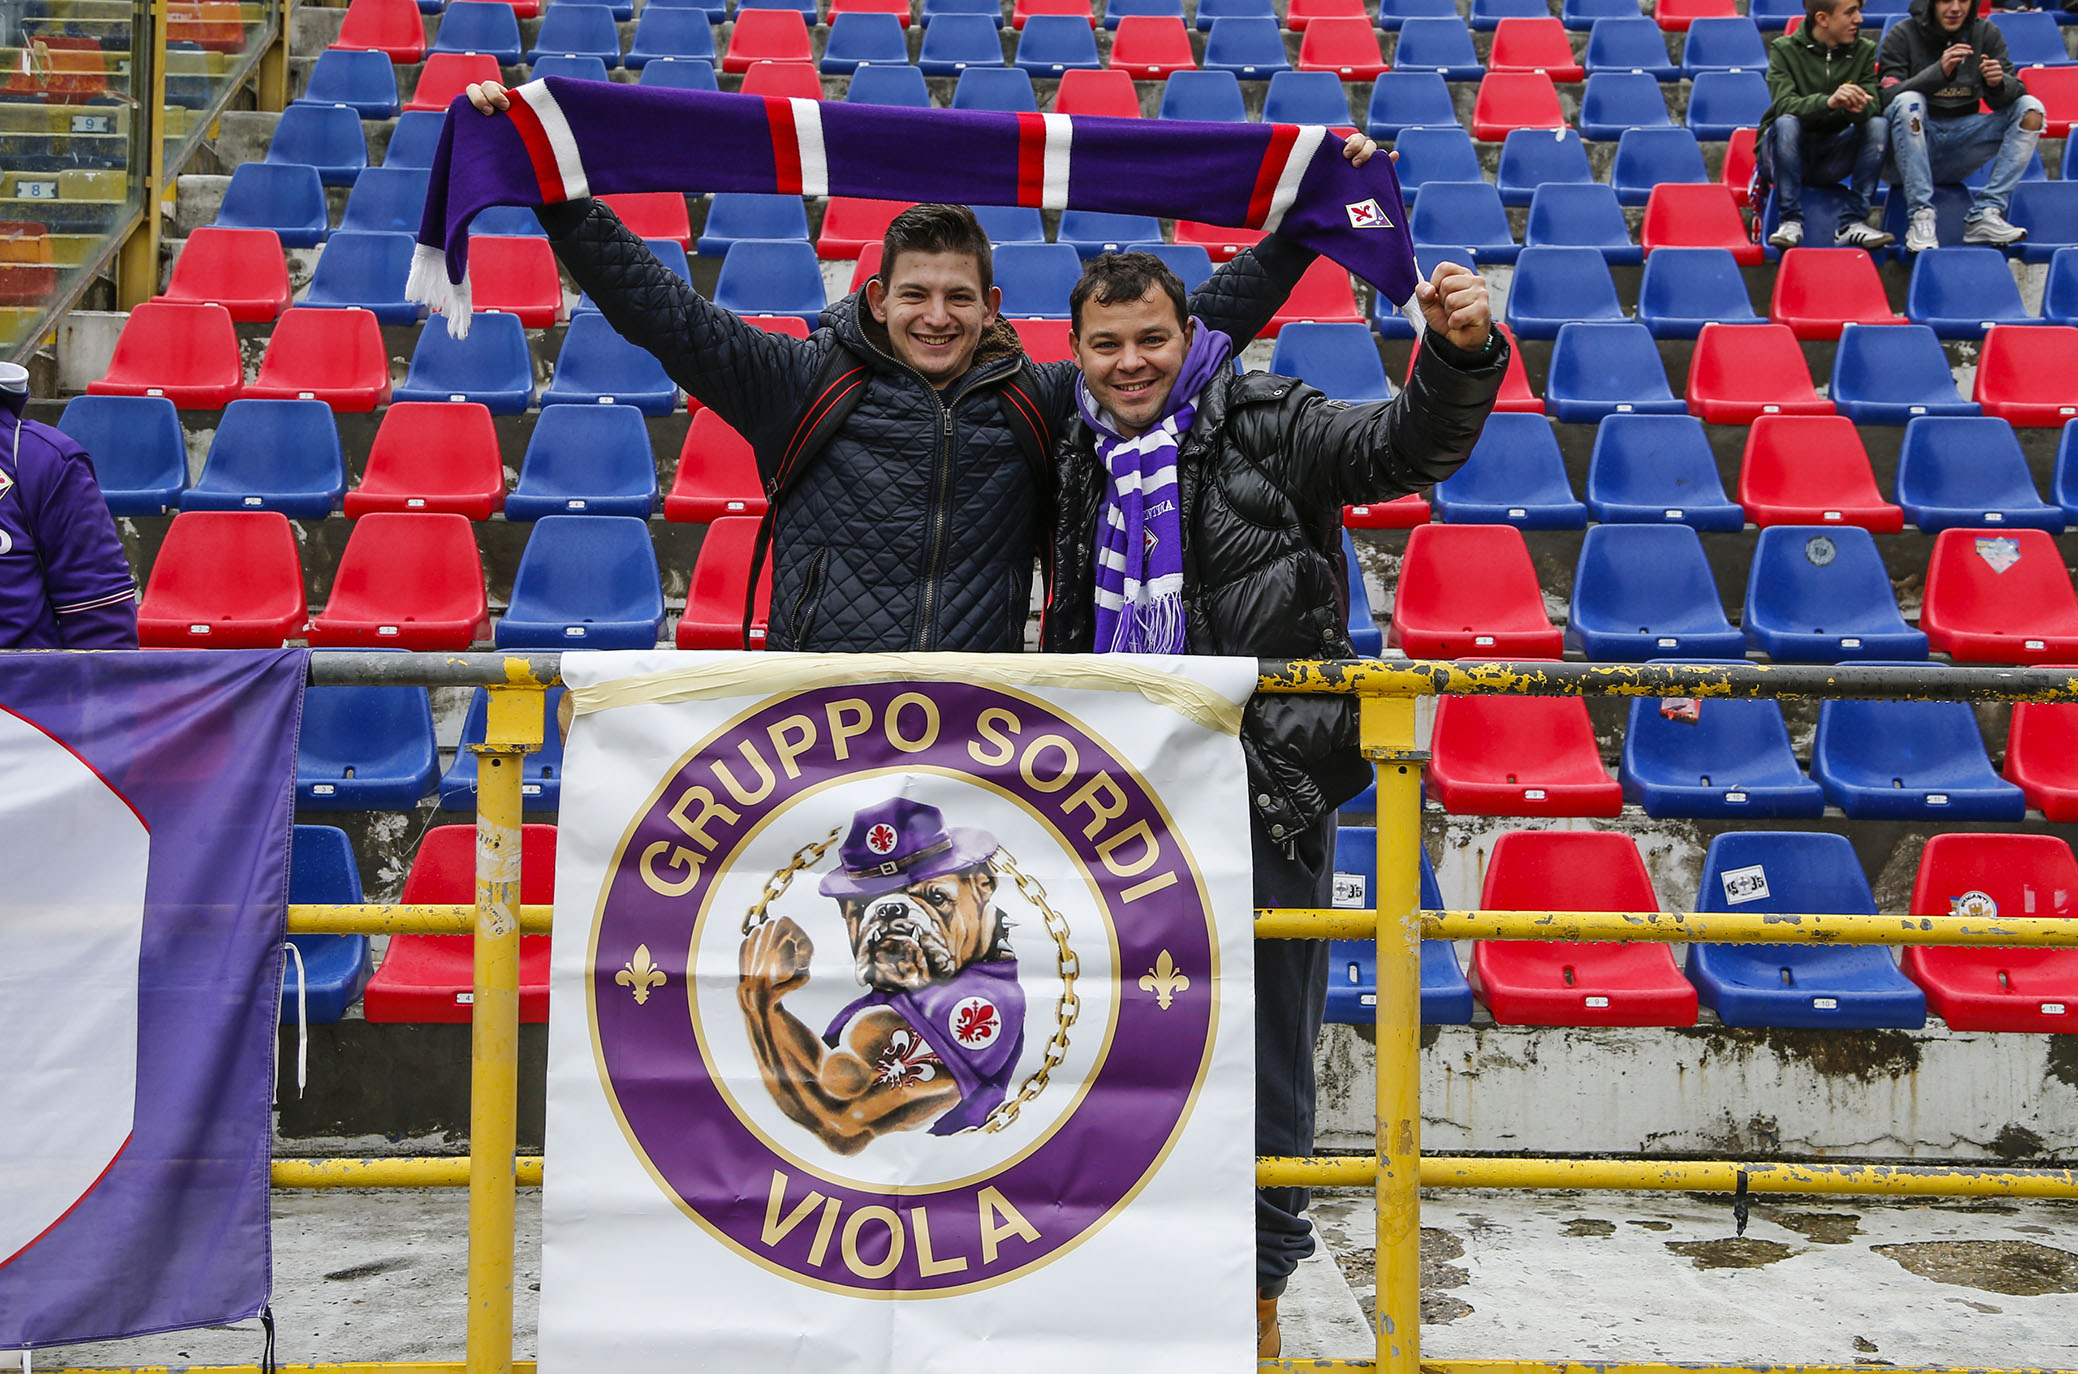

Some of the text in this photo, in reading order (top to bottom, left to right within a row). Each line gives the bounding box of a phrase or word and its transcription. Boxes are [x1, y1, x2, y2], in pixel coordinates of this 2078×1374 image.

[85, 118, 95, 130] 9
[31, 184, 41, 196] 8
[639, 692, 1179, 903] GRUPPO SORDI
[759, 1169, 1042, 1280] VIOLA
